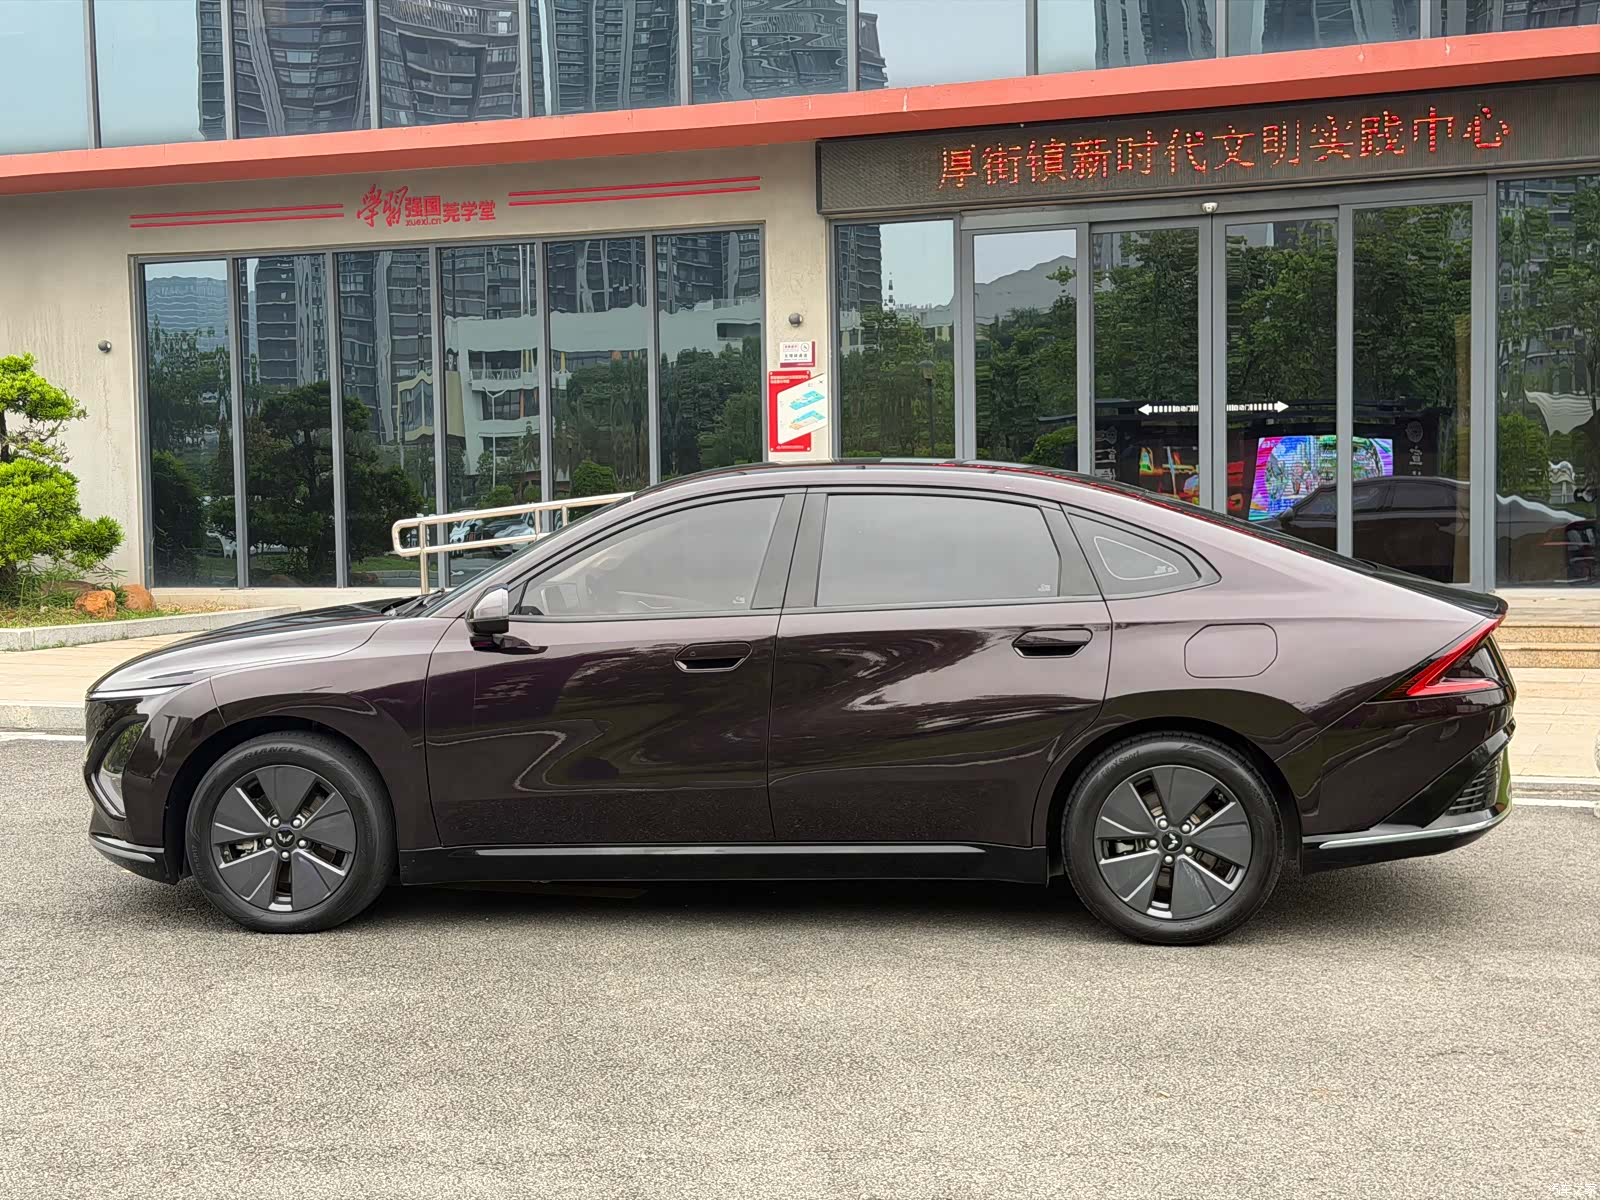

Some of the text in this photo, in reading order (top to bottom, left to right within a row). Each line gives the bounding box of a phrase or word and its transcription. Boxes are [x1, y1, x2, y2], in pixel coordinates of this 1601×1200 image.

[937, 105, 1511, 190] 厚街镇新时代文明实践中心
[406, 217, 442, 227] xuexi.cn
